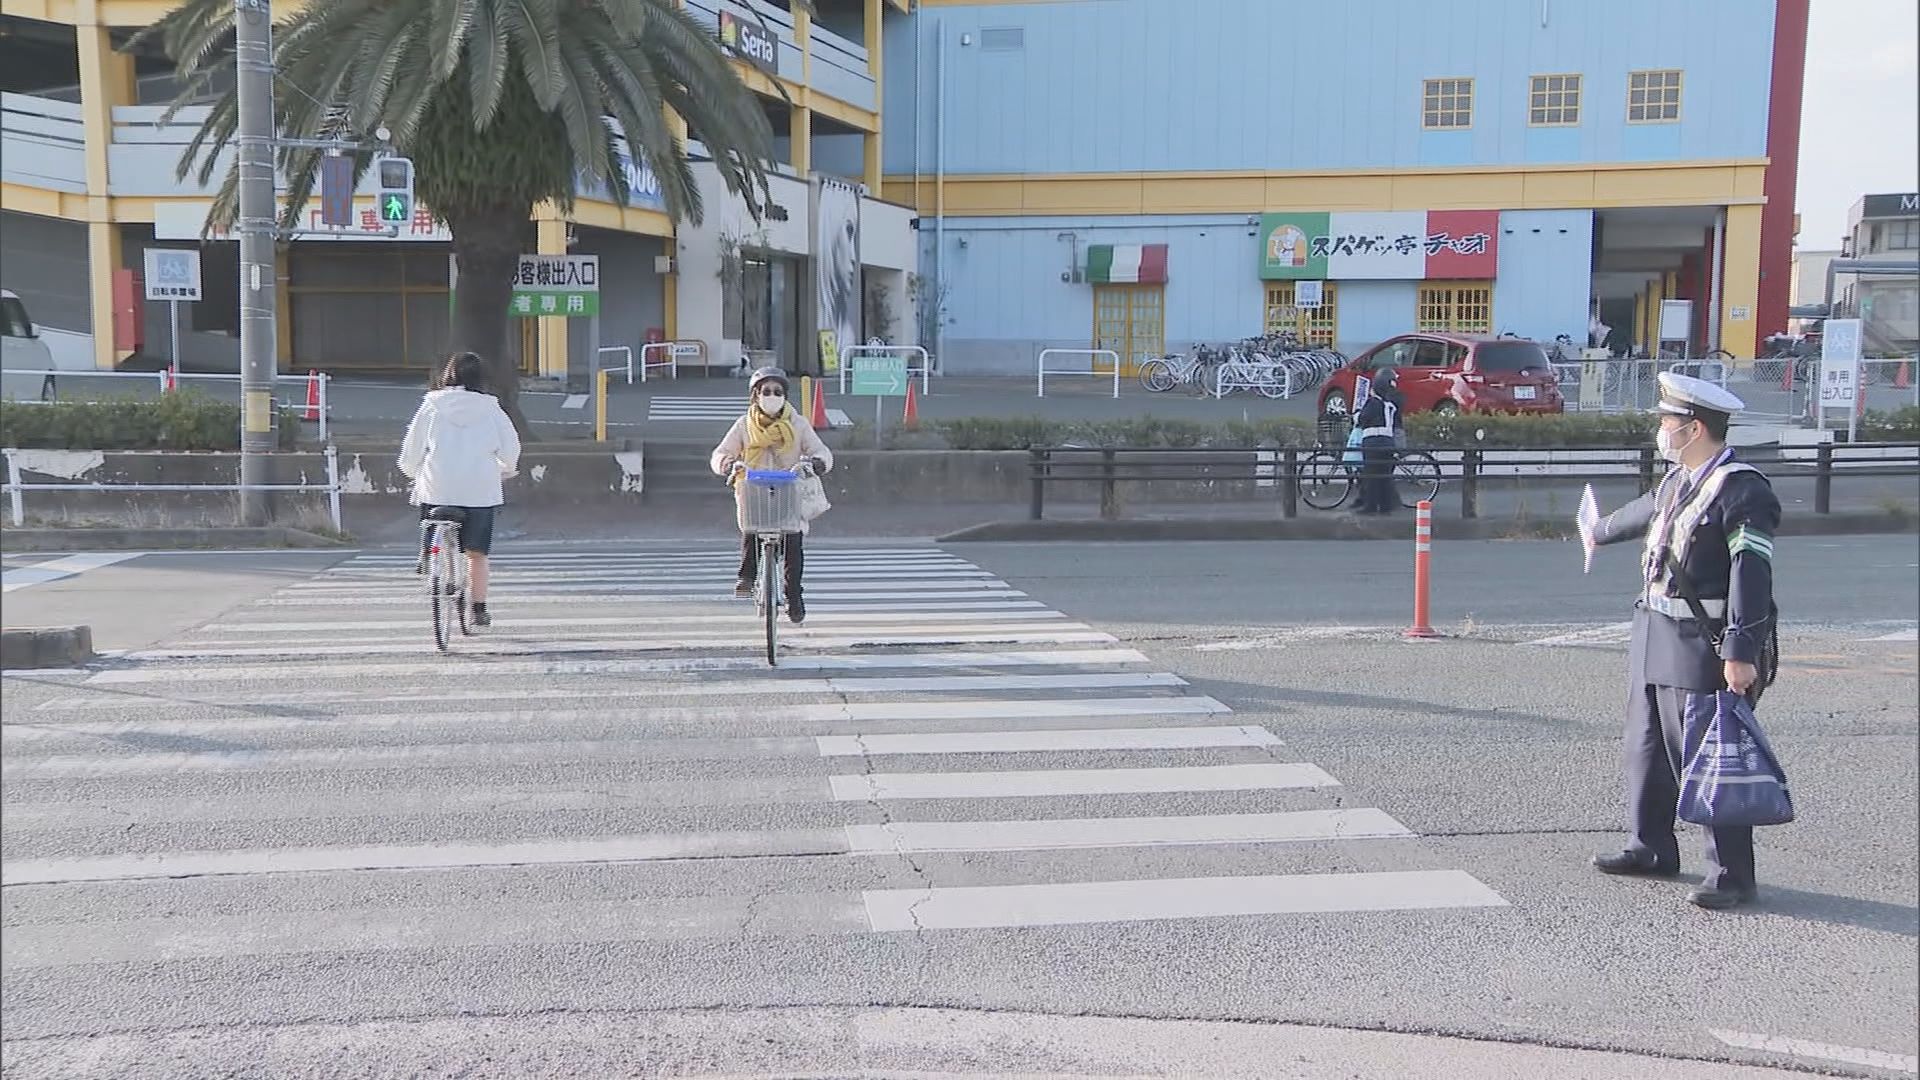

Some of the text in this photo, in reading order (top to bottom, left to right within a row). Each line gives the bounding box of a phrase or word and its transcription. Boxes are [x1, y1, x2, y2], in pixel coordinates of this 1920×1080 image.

[741, 25, 773, 62] Seria
[1828, 370, 1849, 383] 専用
[1821, 386, 1853, 400] 出入口
